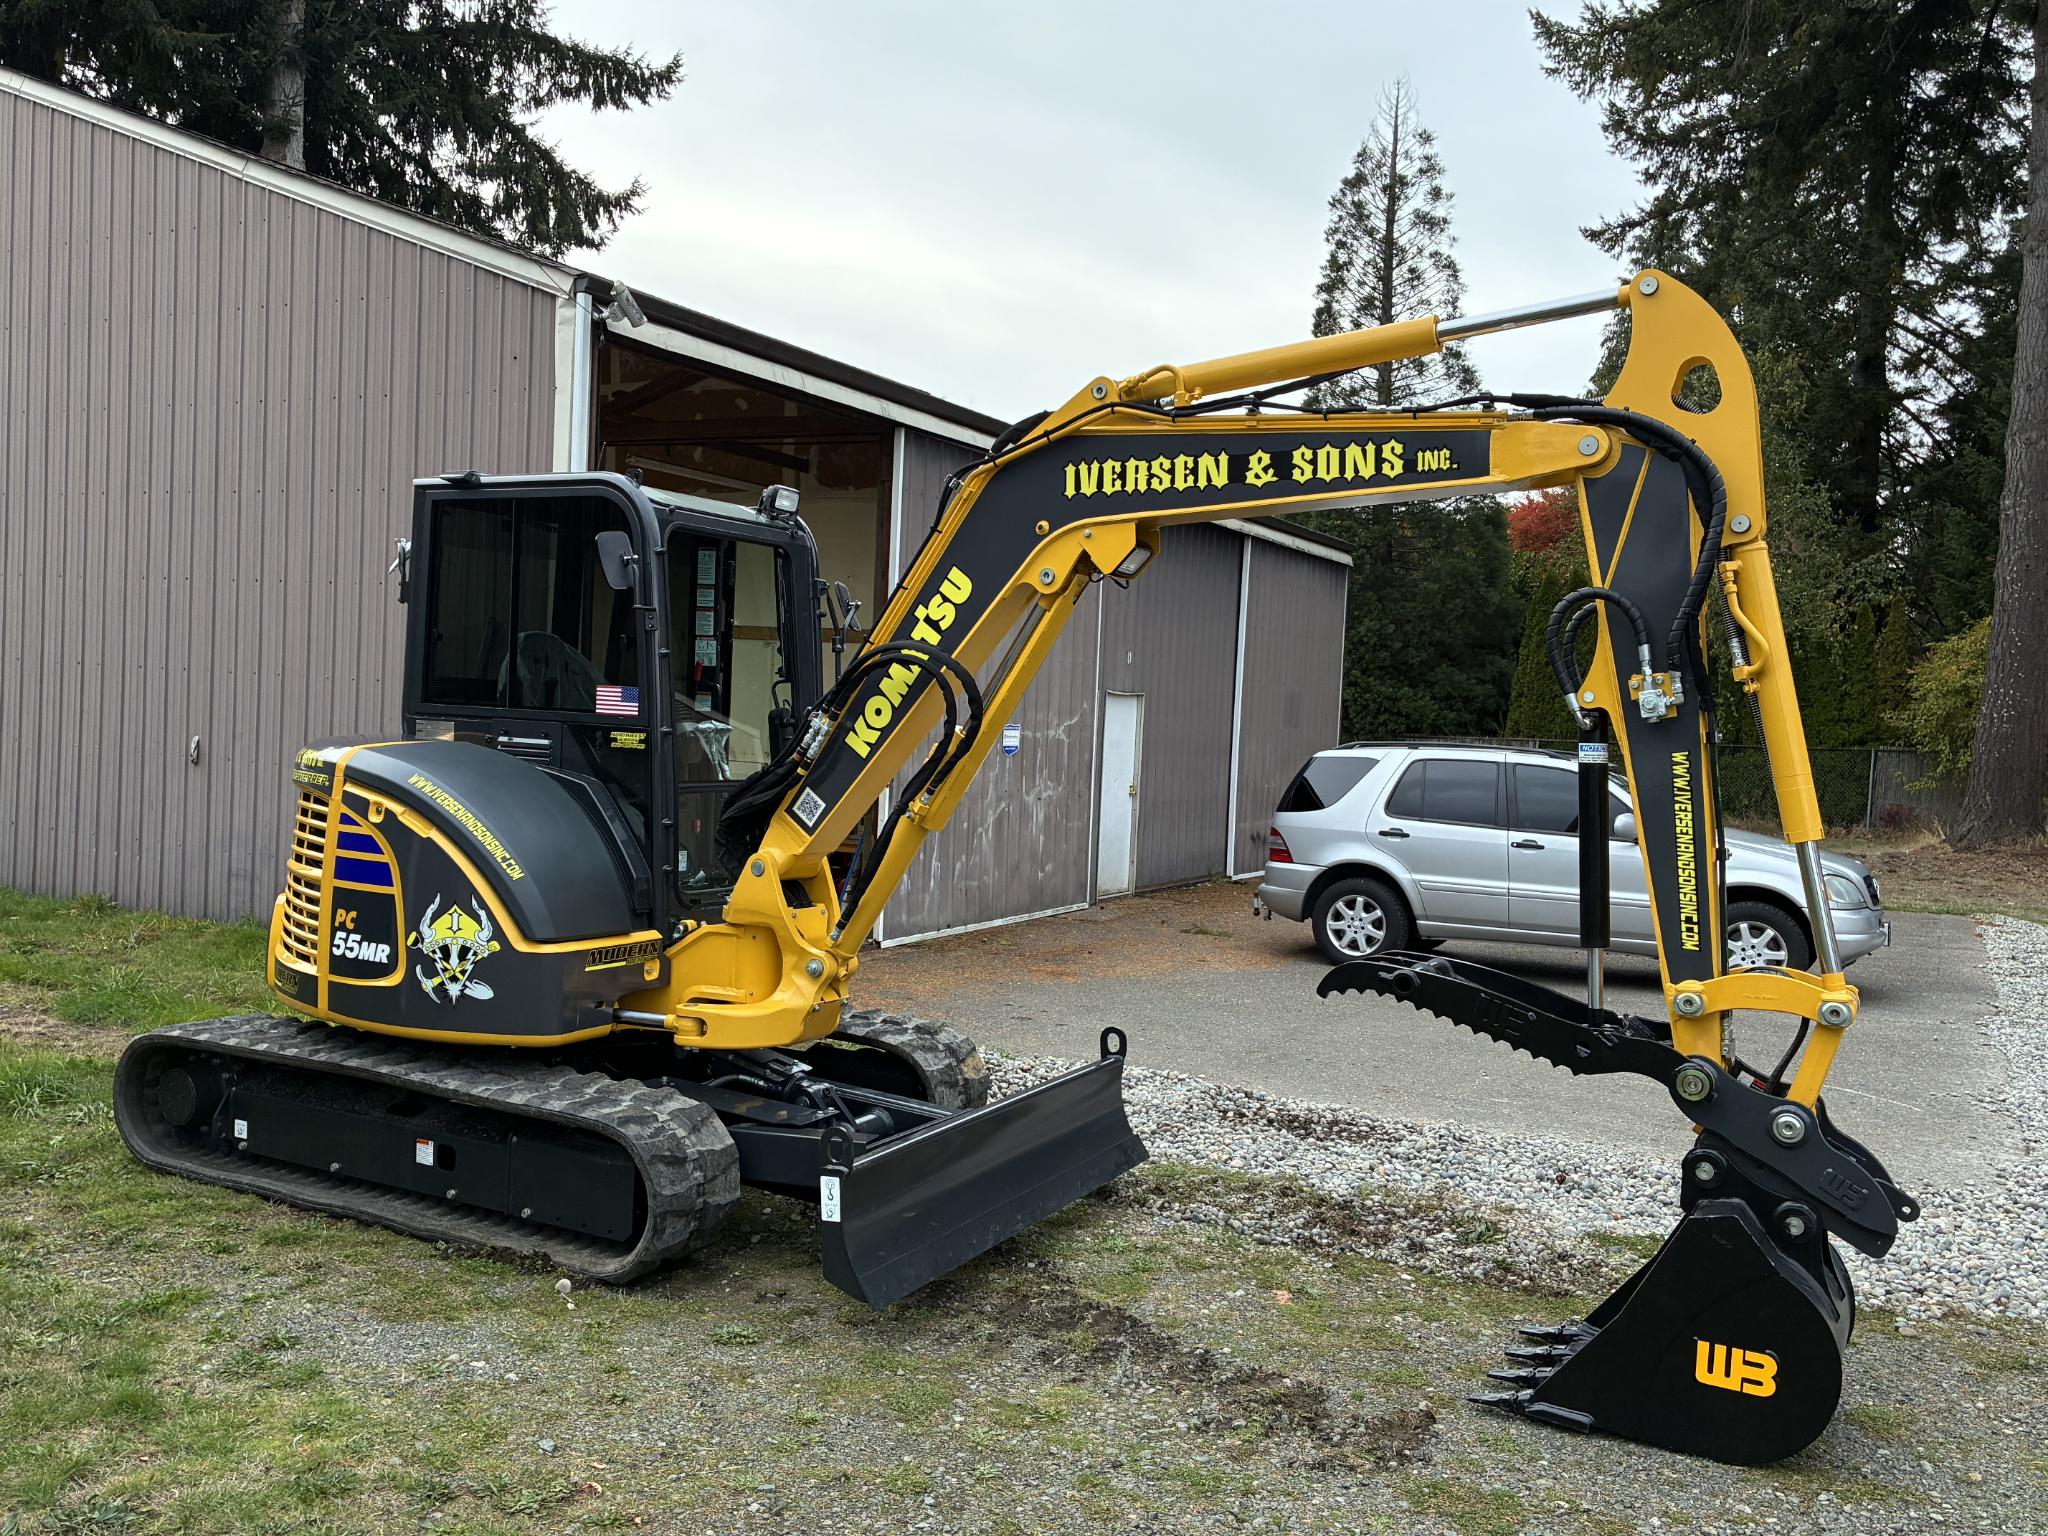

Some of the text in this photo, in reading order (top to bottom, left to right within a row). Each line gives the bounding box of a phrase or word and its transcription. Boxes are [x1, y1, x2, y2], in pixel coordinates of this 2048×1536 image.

[1063, 438, 1458, 500] IVERSEN & SONS INC.
[334, 909, 358, 930] PC
[332, 931, 391, 964] 55MR
